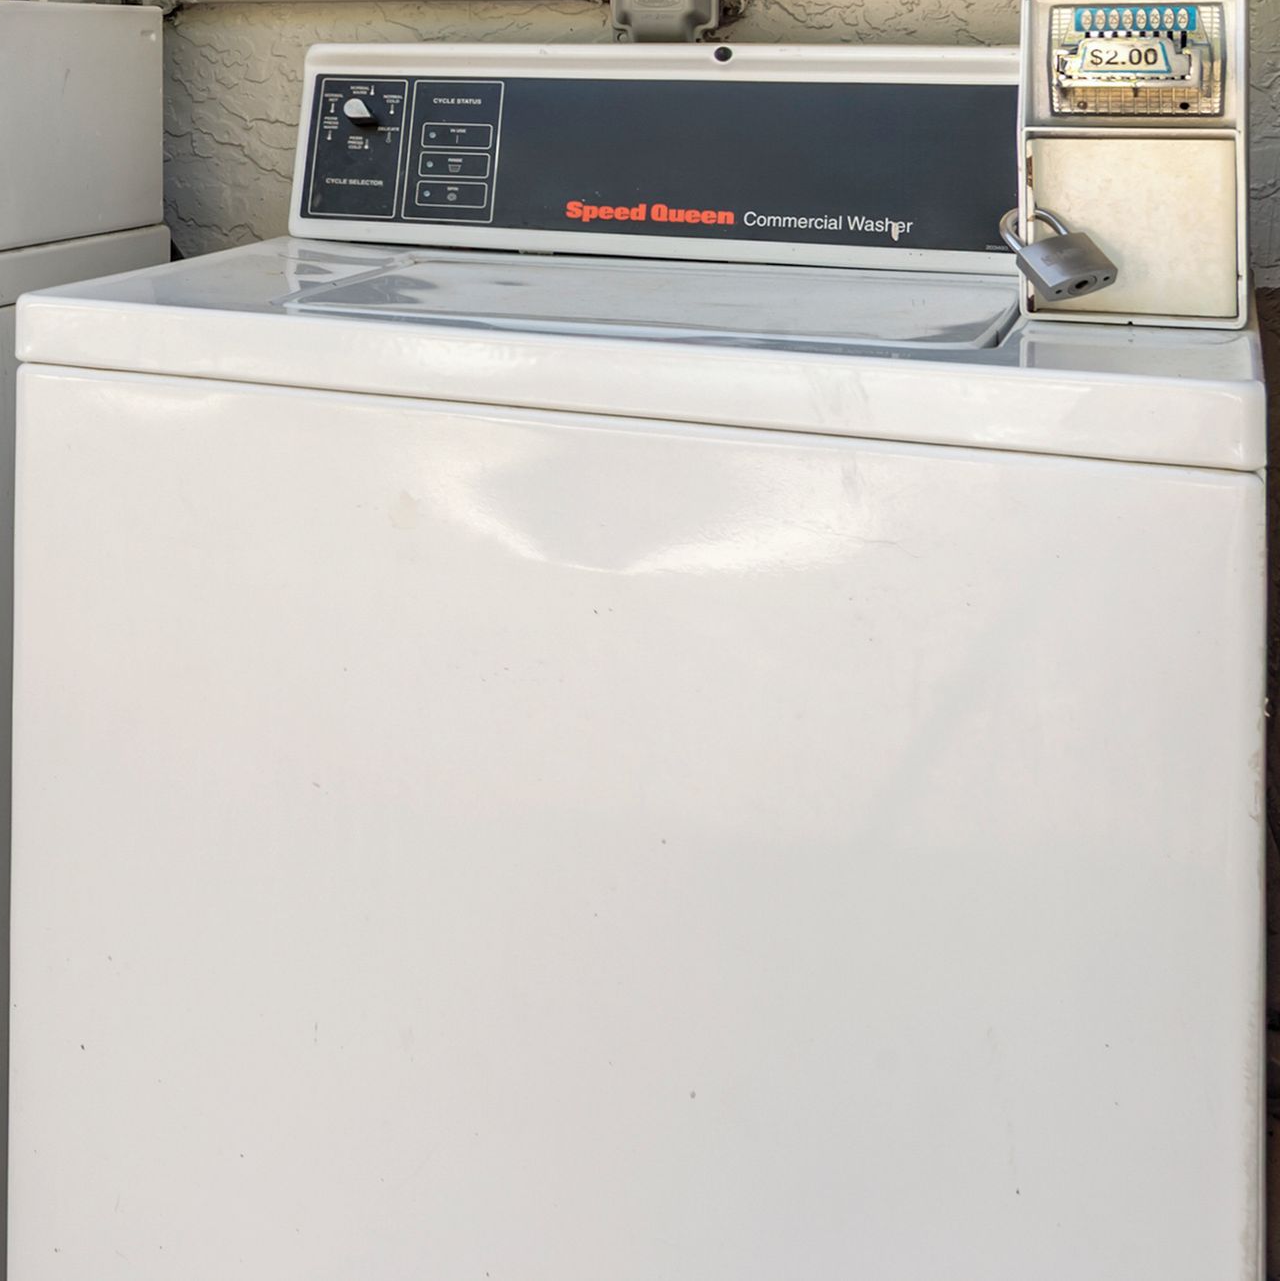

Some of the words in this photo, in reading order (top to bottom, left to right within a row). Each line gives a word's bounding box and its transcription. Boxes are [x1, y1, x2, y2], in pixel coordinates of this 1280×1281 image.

[1090, 47, 1158, 66] $2.00
[432, 97, 455, 105] CYCLE
[349, 179, 384, 187] SELECTOR
[565, 200, 647, 223] Speed
[650, 204, 735, 225] Queen
[743, 211, 843, 230] Commercial
[847, 216, 914, 234] Washer
